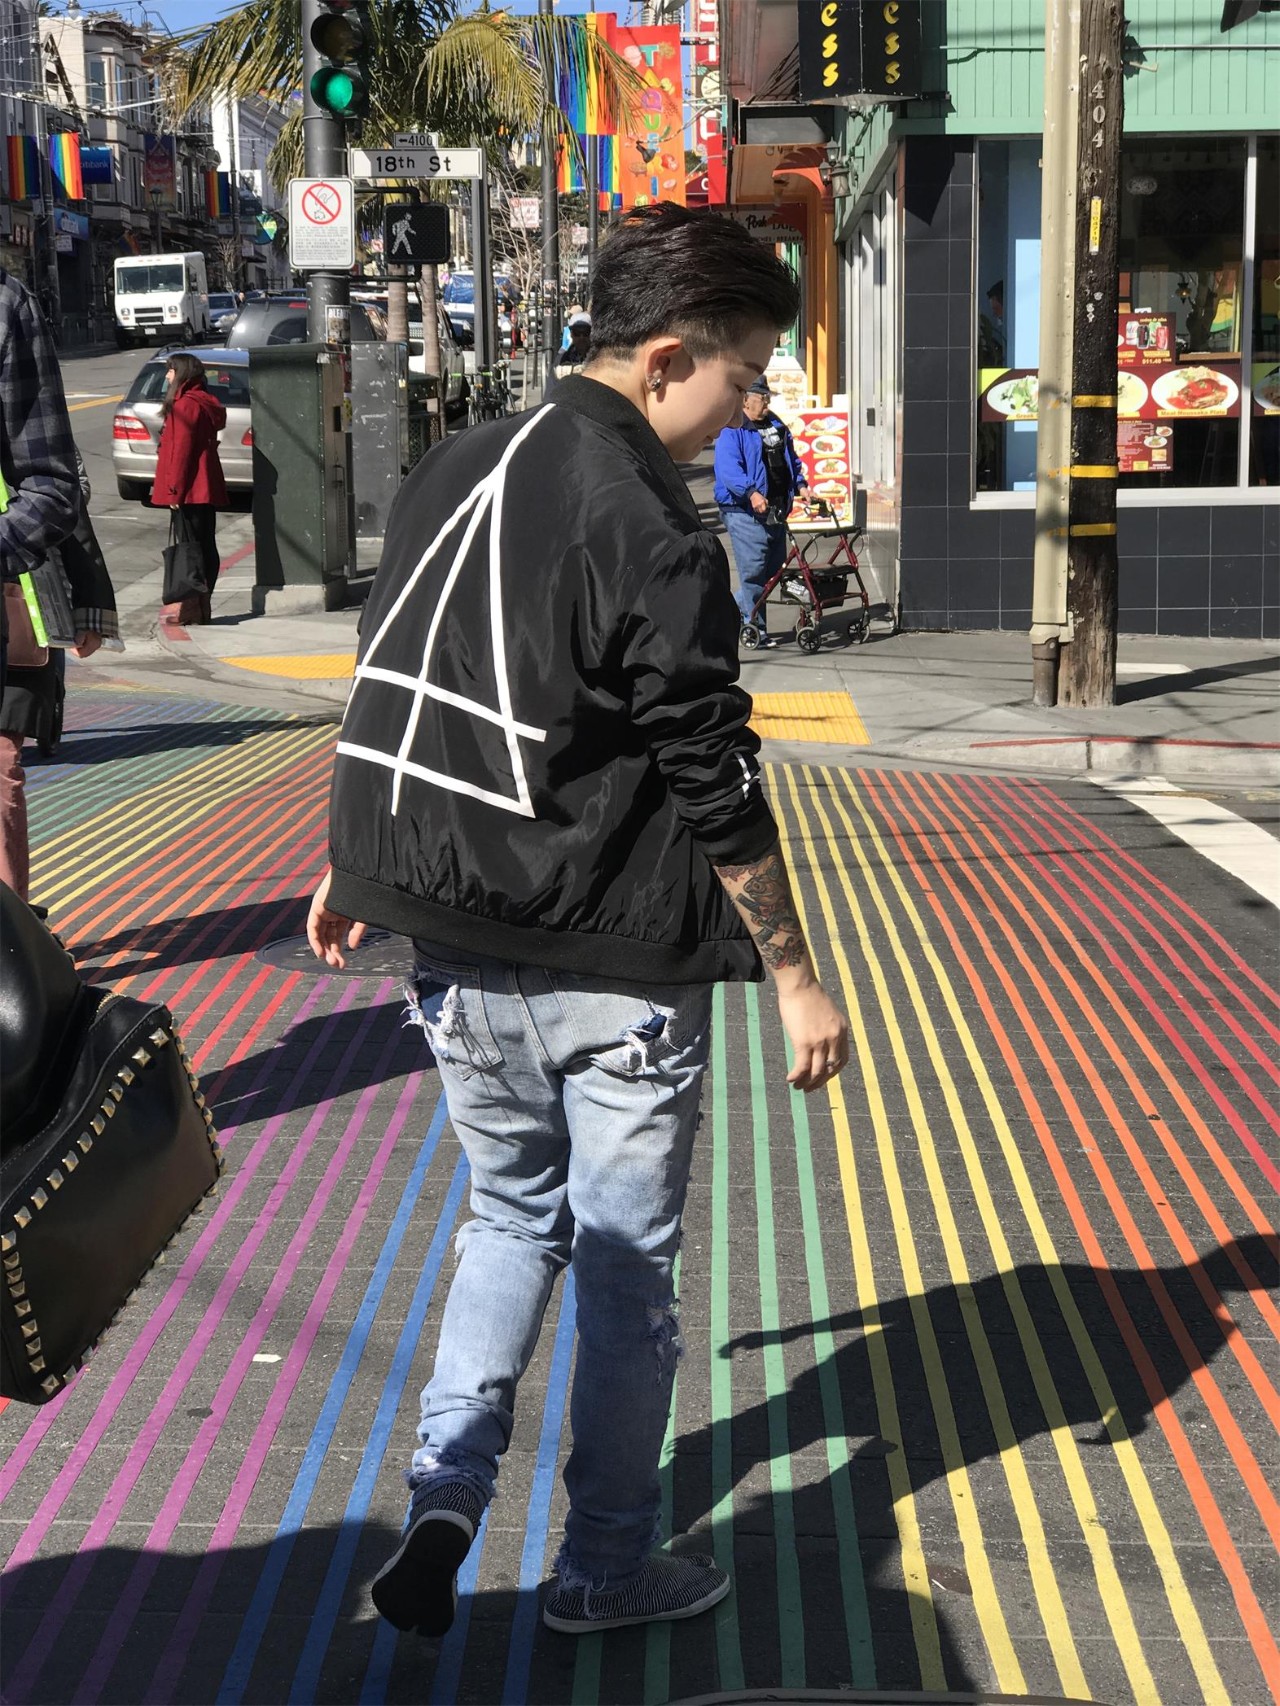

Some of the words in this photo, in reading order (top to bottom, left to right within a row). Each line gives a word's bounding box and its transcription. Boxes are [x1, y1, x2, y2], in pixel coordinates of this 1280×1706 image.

[639, 43, 664, 205] TAQUERI
[1091, 79, 1106, 149] 404
[408, 135, 433, 146] 4100
[376, 156, 415, 173] 18th
[429, 156, 452, 172] St
